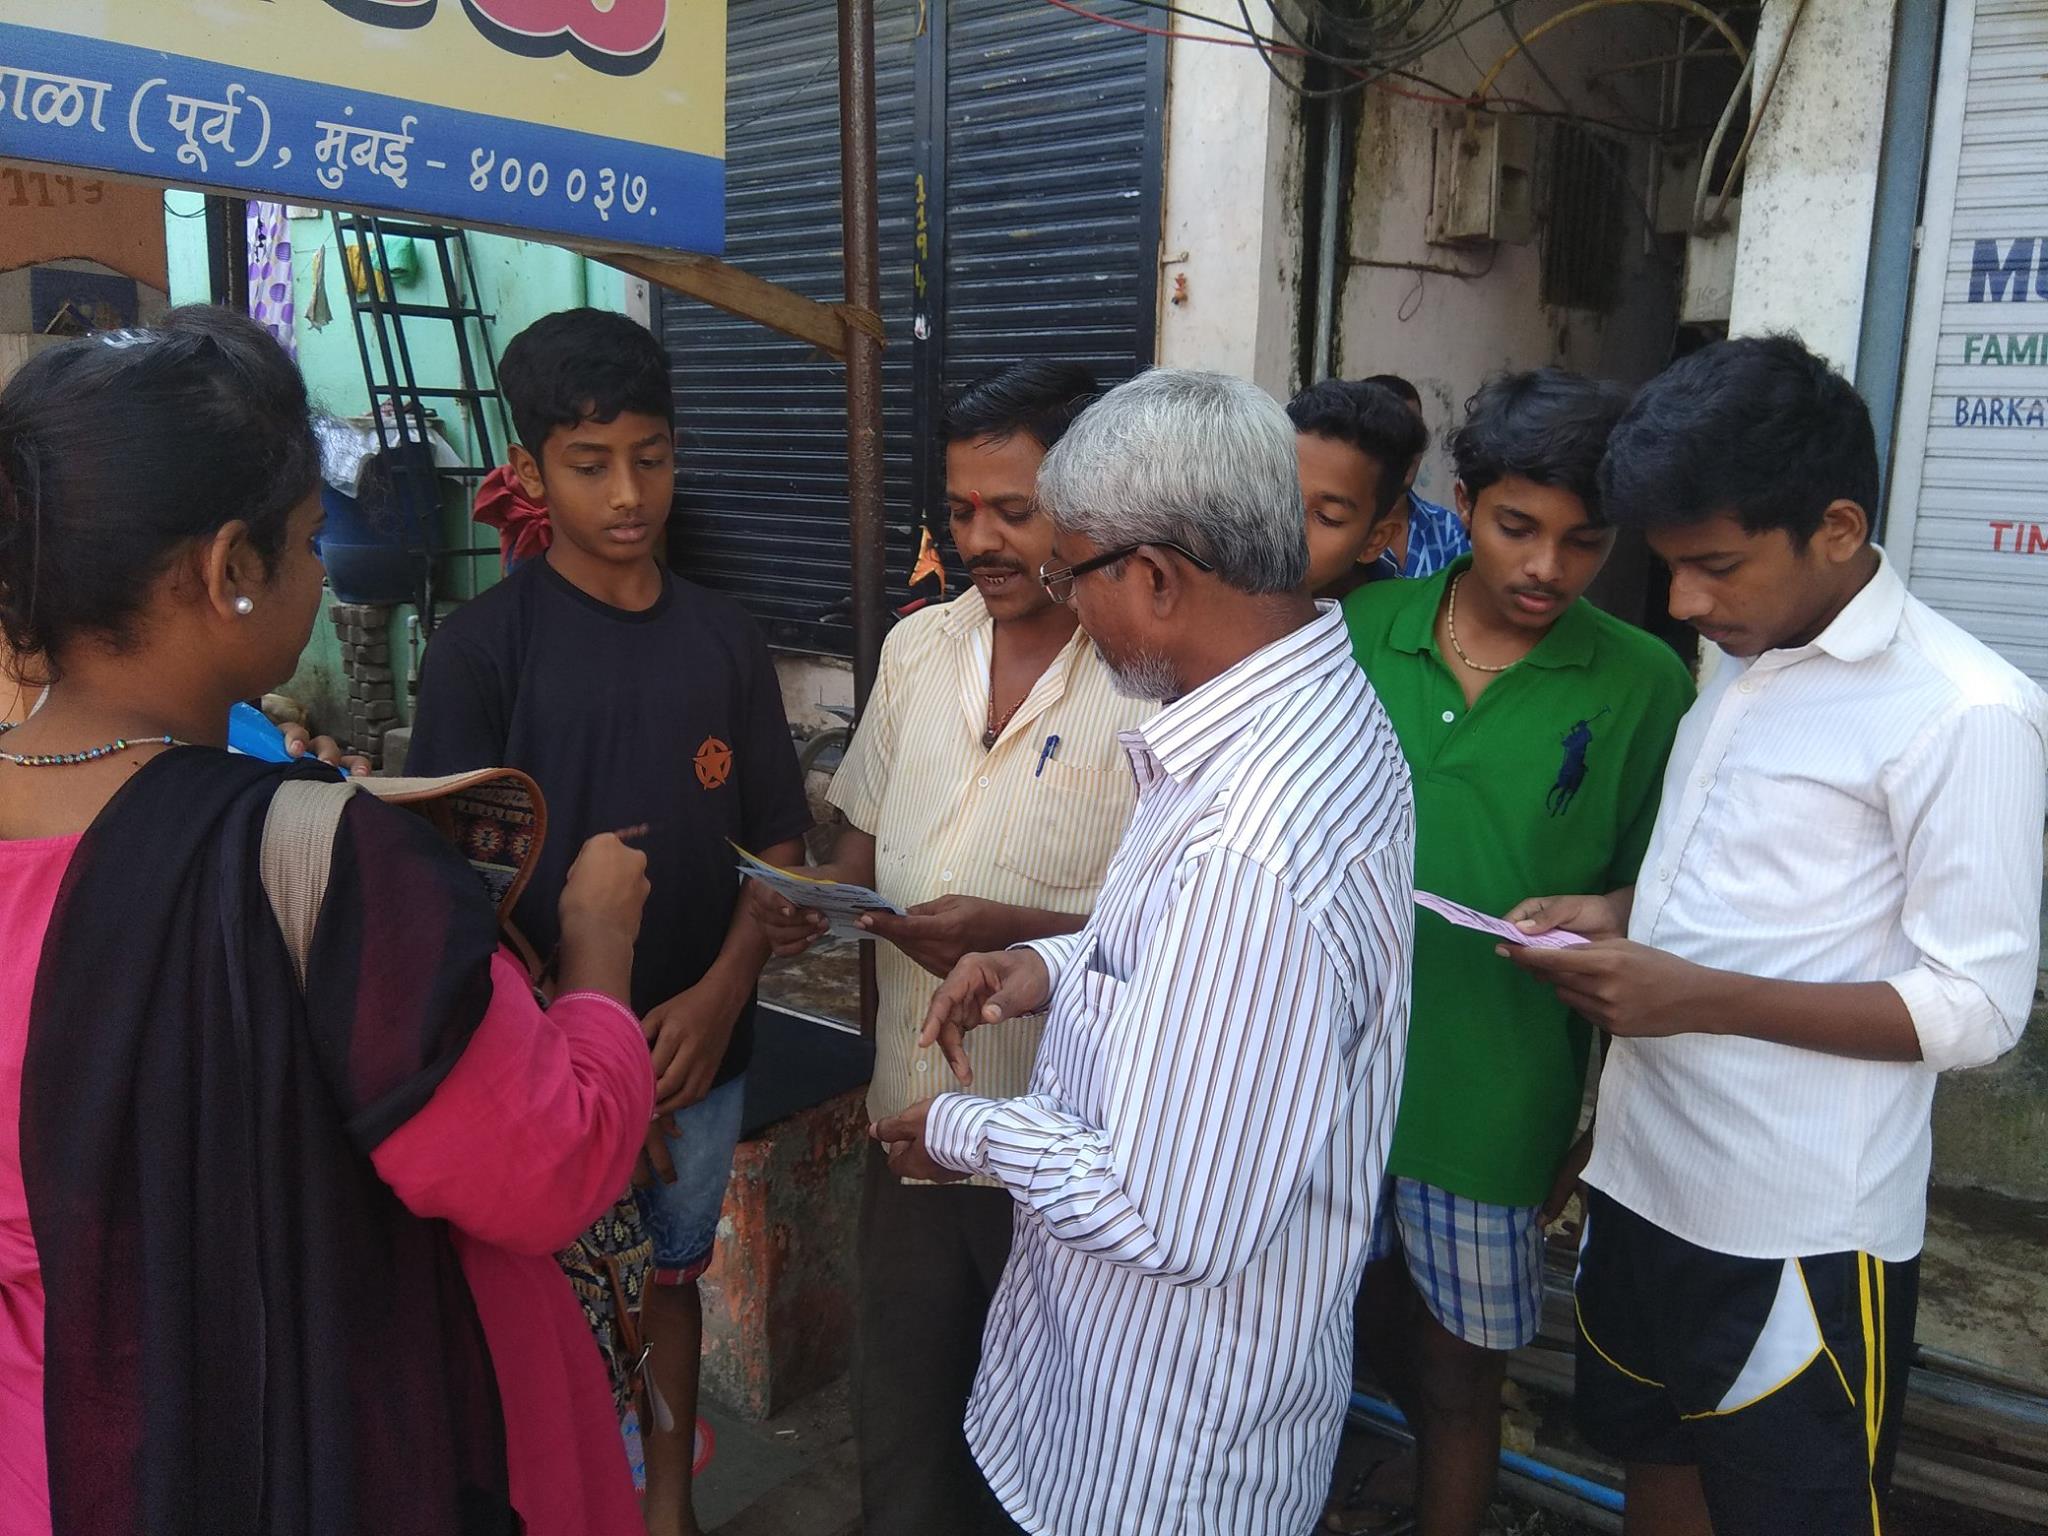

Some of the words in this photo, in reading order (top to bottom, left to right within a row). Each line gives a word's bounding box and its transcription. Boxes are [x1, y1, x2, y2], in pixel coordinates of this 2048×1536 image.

[129, 78, 292, 173] (पूर्व),
[315, 106, 418, 190] मुंबई
[469, 147, 549, 197] ४००
[566, 167, 656, 222] ०३७.
[1968, 238, 2048, 303] M
[1955, 396, 2048, 427] BARKA
